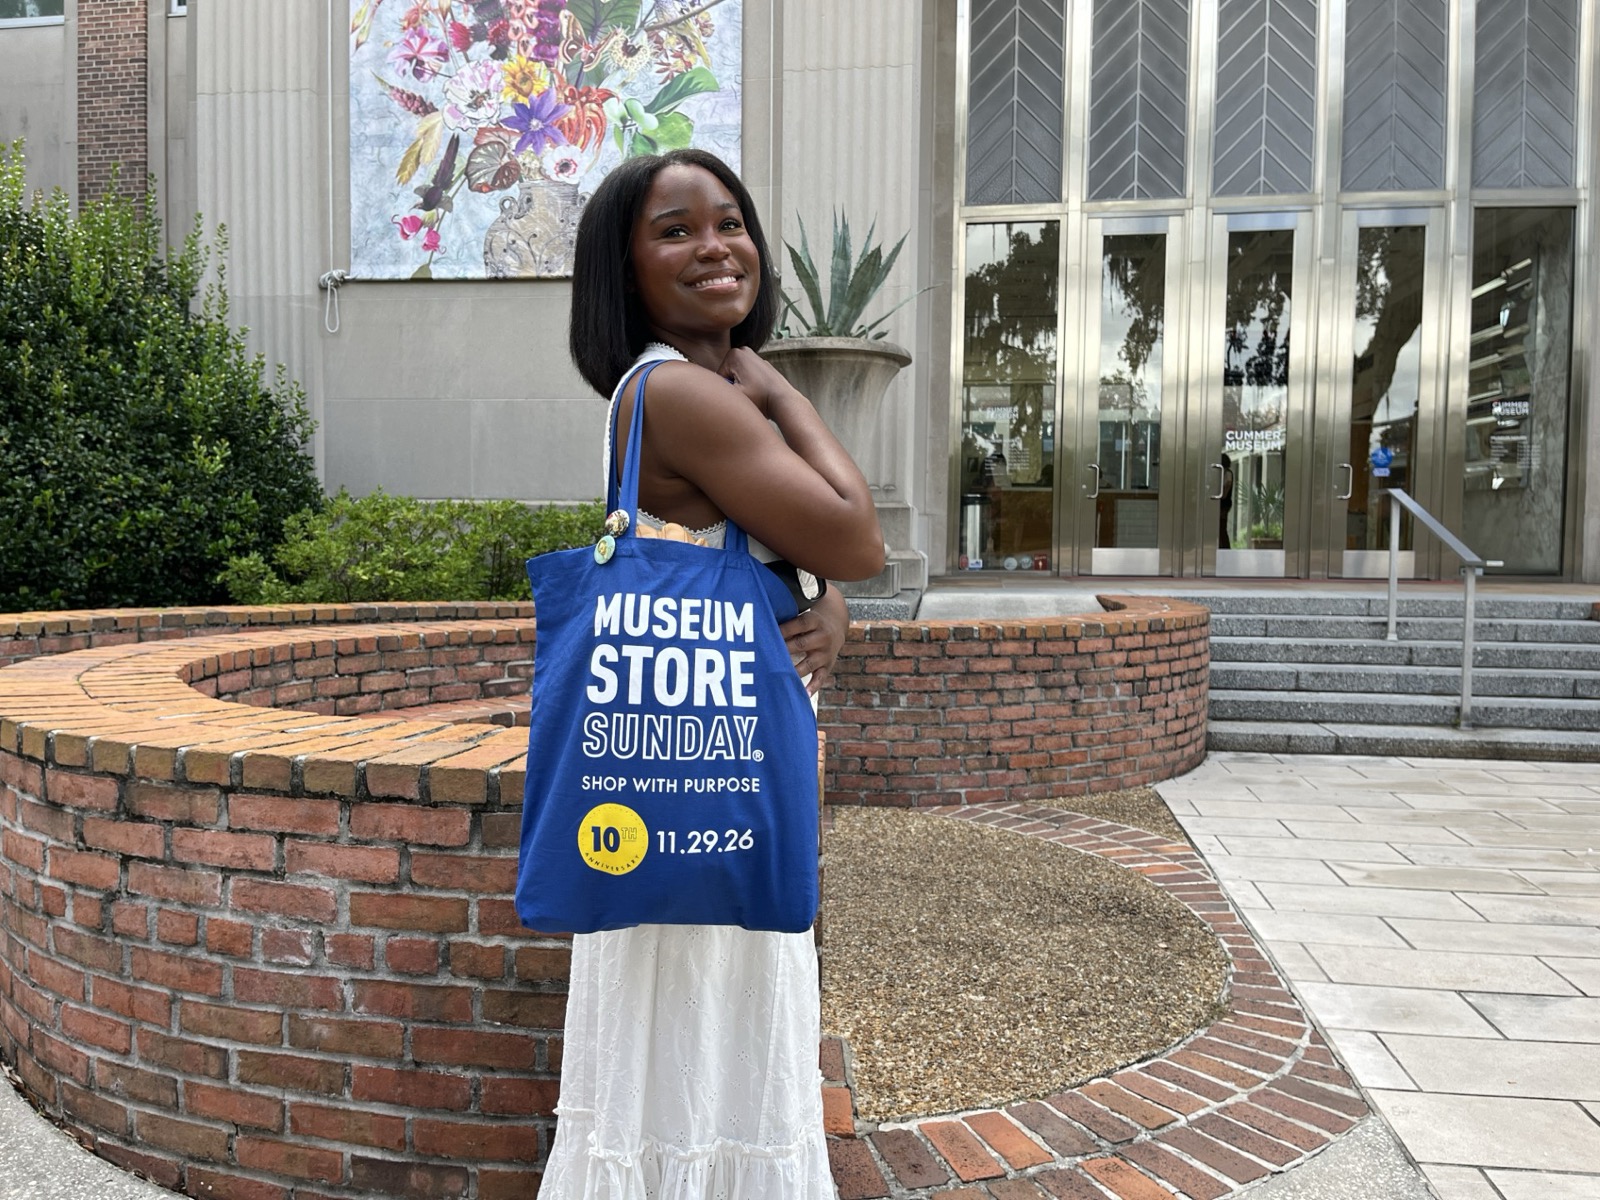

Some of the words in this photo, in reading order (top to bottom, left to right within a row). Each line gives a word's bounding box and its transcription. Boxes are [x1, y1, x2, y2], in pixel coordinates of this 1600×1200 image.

[1225, 430, 1281, 440] CUMMER
[1225, 440, 1281, 451] MUSEUM
[594, 592, 754, 643] MUSEUM
[586, 643, 757, 708] STORE
[581, 776, 627, 792] SHOP
[633, 777, 678, 793] WITH
[684, 777, 761, 793] PURPOSE
[656, 829, 754, 854] 11.29.26
[585, 852, 640, 872] ANNIVERSARY
